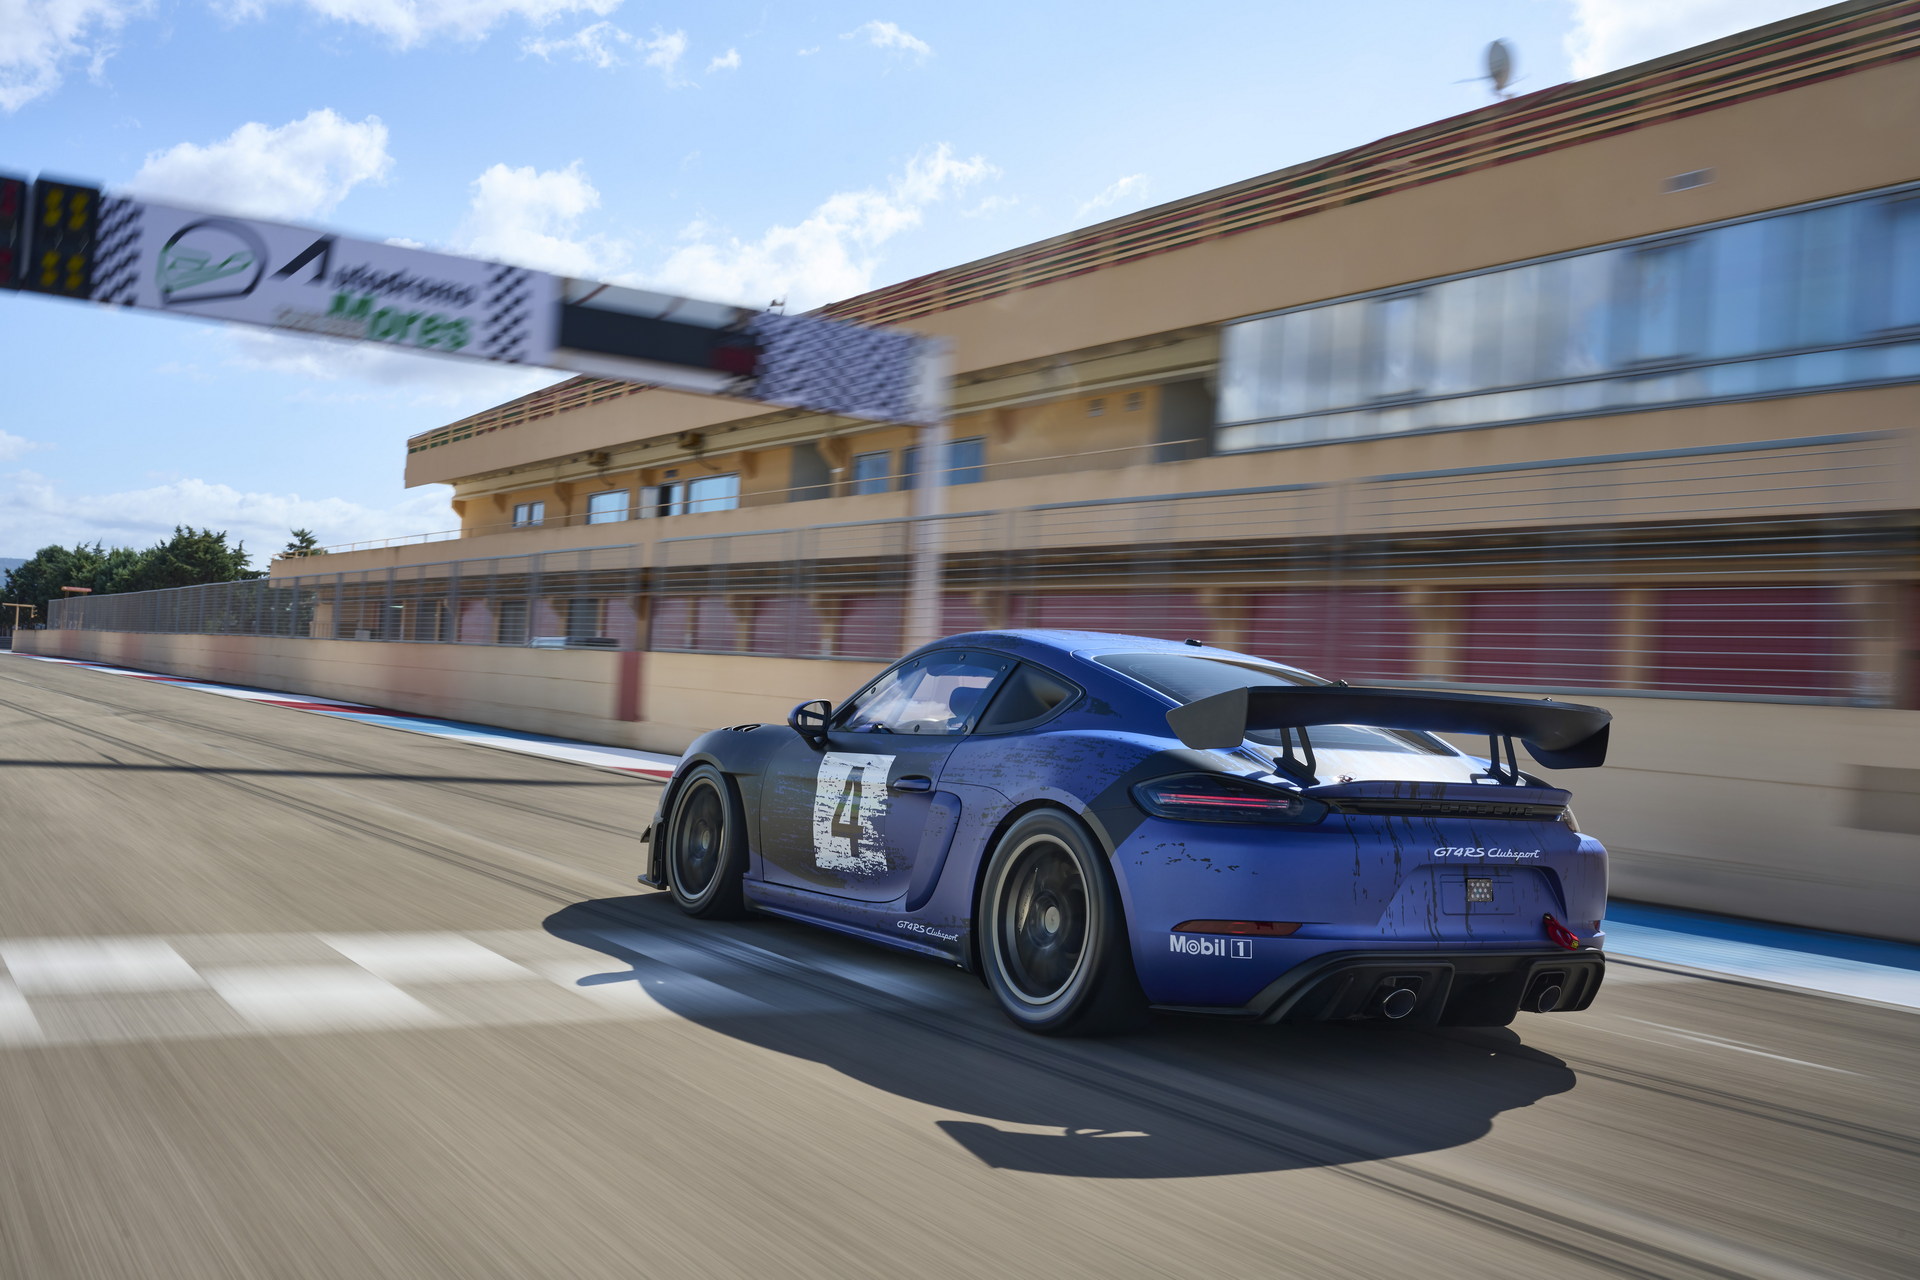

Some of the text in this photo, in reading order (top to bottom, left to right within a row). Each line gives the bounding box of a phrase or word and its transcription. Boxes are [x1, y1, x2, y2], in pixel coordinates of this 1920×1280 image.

[327, 291, 473, 352] Mores
[831, 766, 865, 858] 4
[1420, 803, 1535, 816] PORSCHE
[1487, 847, 1541, 861] Clubsport
[925, 926, 959, 942] Clubsport
[1169, 934, 1226, 957] Mobil
